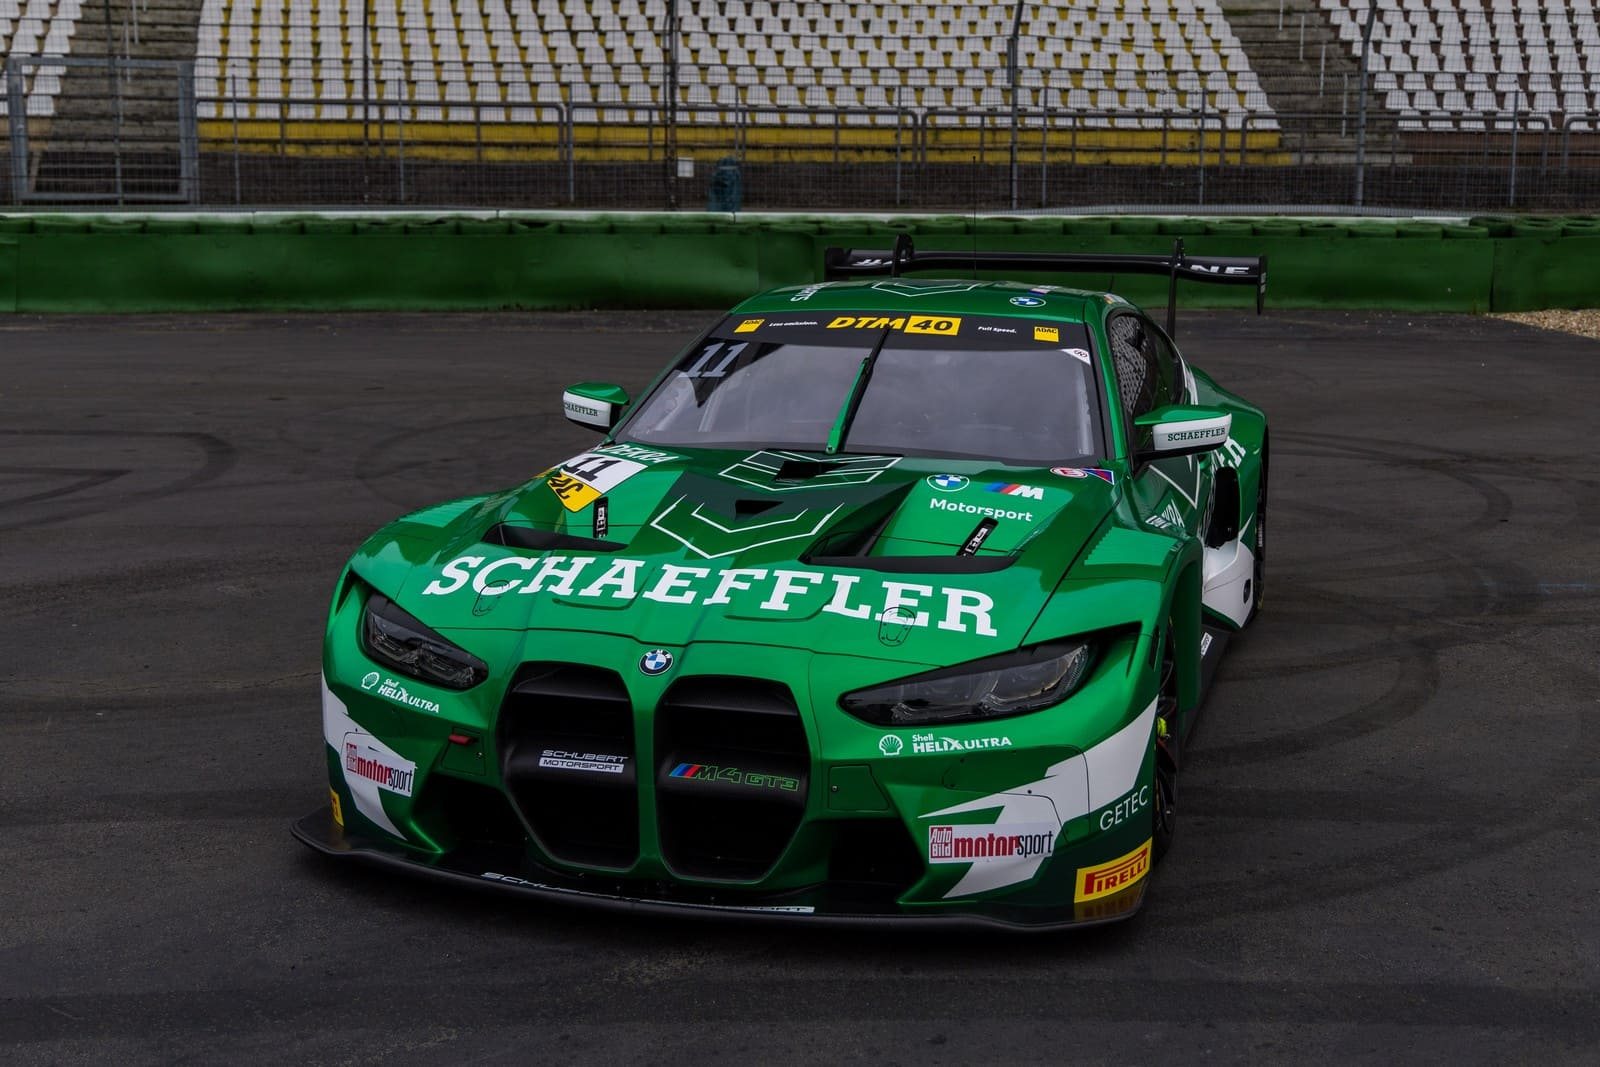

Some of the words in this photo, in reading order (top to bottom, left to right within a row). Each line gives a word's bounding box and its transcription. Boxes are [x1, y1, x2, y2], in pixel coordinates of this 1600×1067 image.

[826, 317, 905, 329] DTM
[913, 320, 953, 331] 40
[687, 342, 749, 377] 11
[1167, 427, 1225, 441] SCHAEFFLER
[597, 444, 680, 463] DEKRA
[562, 457, 622, 482] 11
[930, 498, 1033, 521] Motorsport
[422, 556, 998, 637] SCHAEFFLER
[912, 733, 934, 742] Shell
[542, 749, 628, 762] SCHUBERT
[542, 759, 621, 771] MOTORSPORT
[745, 773, 799, 792] GT3
[1100, 785, 1148, 831] GETEC
[931, 828, 952, 843] Auto
[932, 843, 952, 856] Bild
[1084, 848, 1148, 896] PIRELLI
